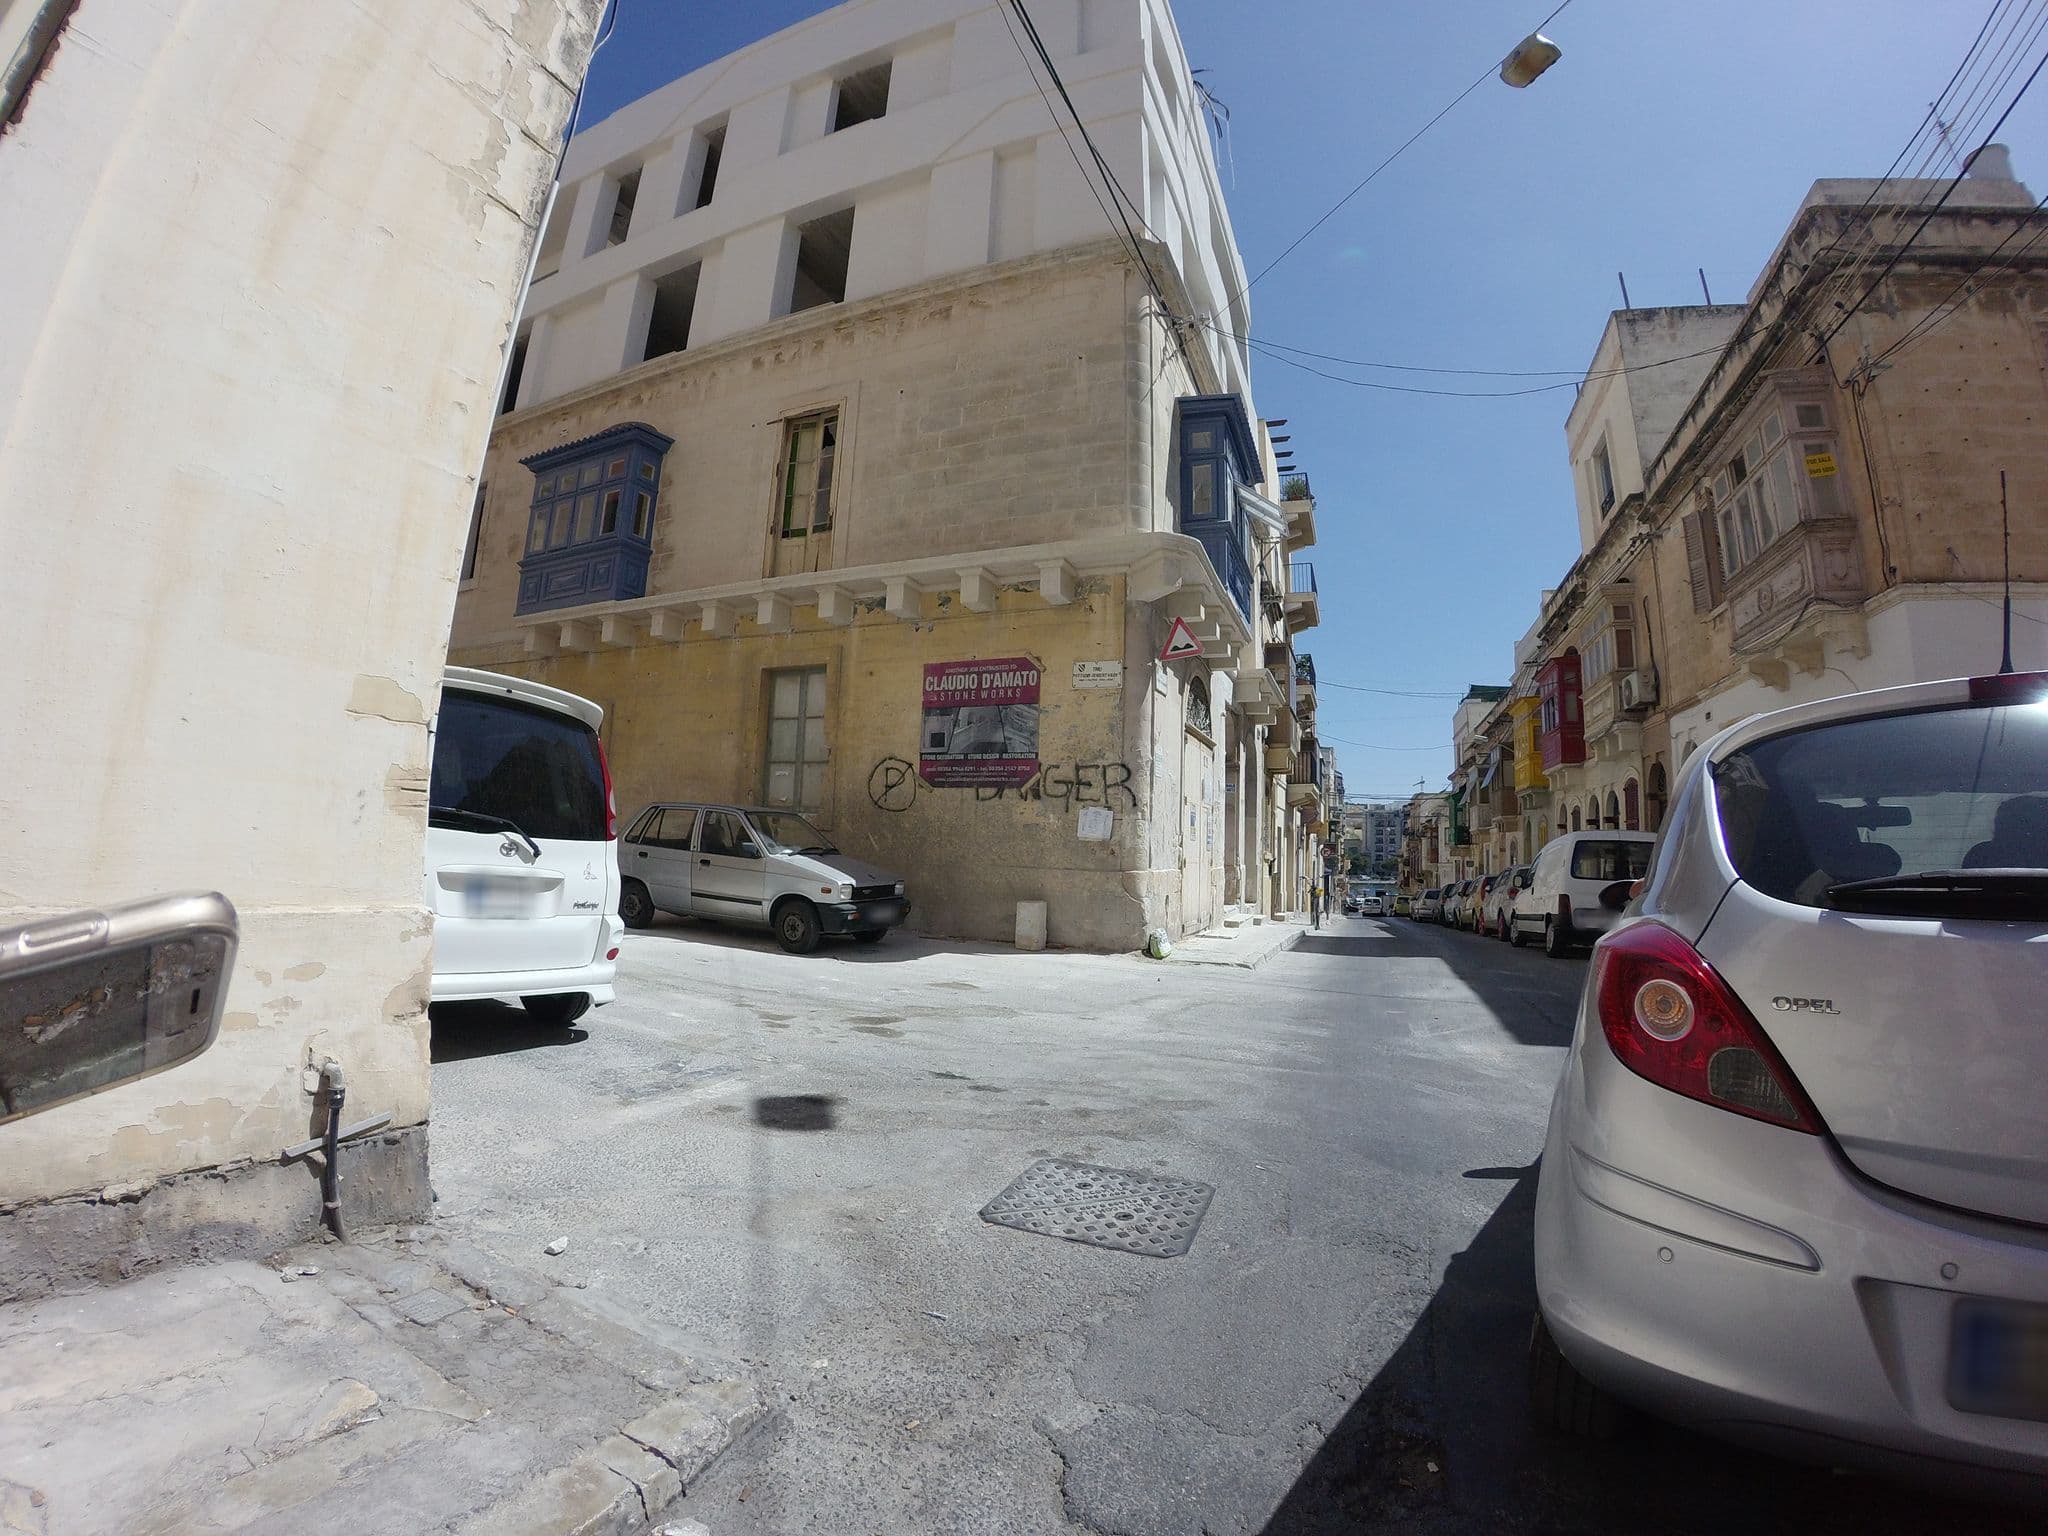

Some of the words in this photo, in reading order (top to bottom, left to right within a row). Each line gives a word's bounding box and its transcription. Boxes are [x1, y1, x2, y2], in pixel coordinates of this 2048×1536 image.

[925, 673, 978, 692] CLAUDIO
[982, 670, 1038, 689] D'AMATO
[940, 690, 977, 702] STONE
[981, 688, 1022, 699] WORKS
[1772, 996, 1840, 1014] OPEL
